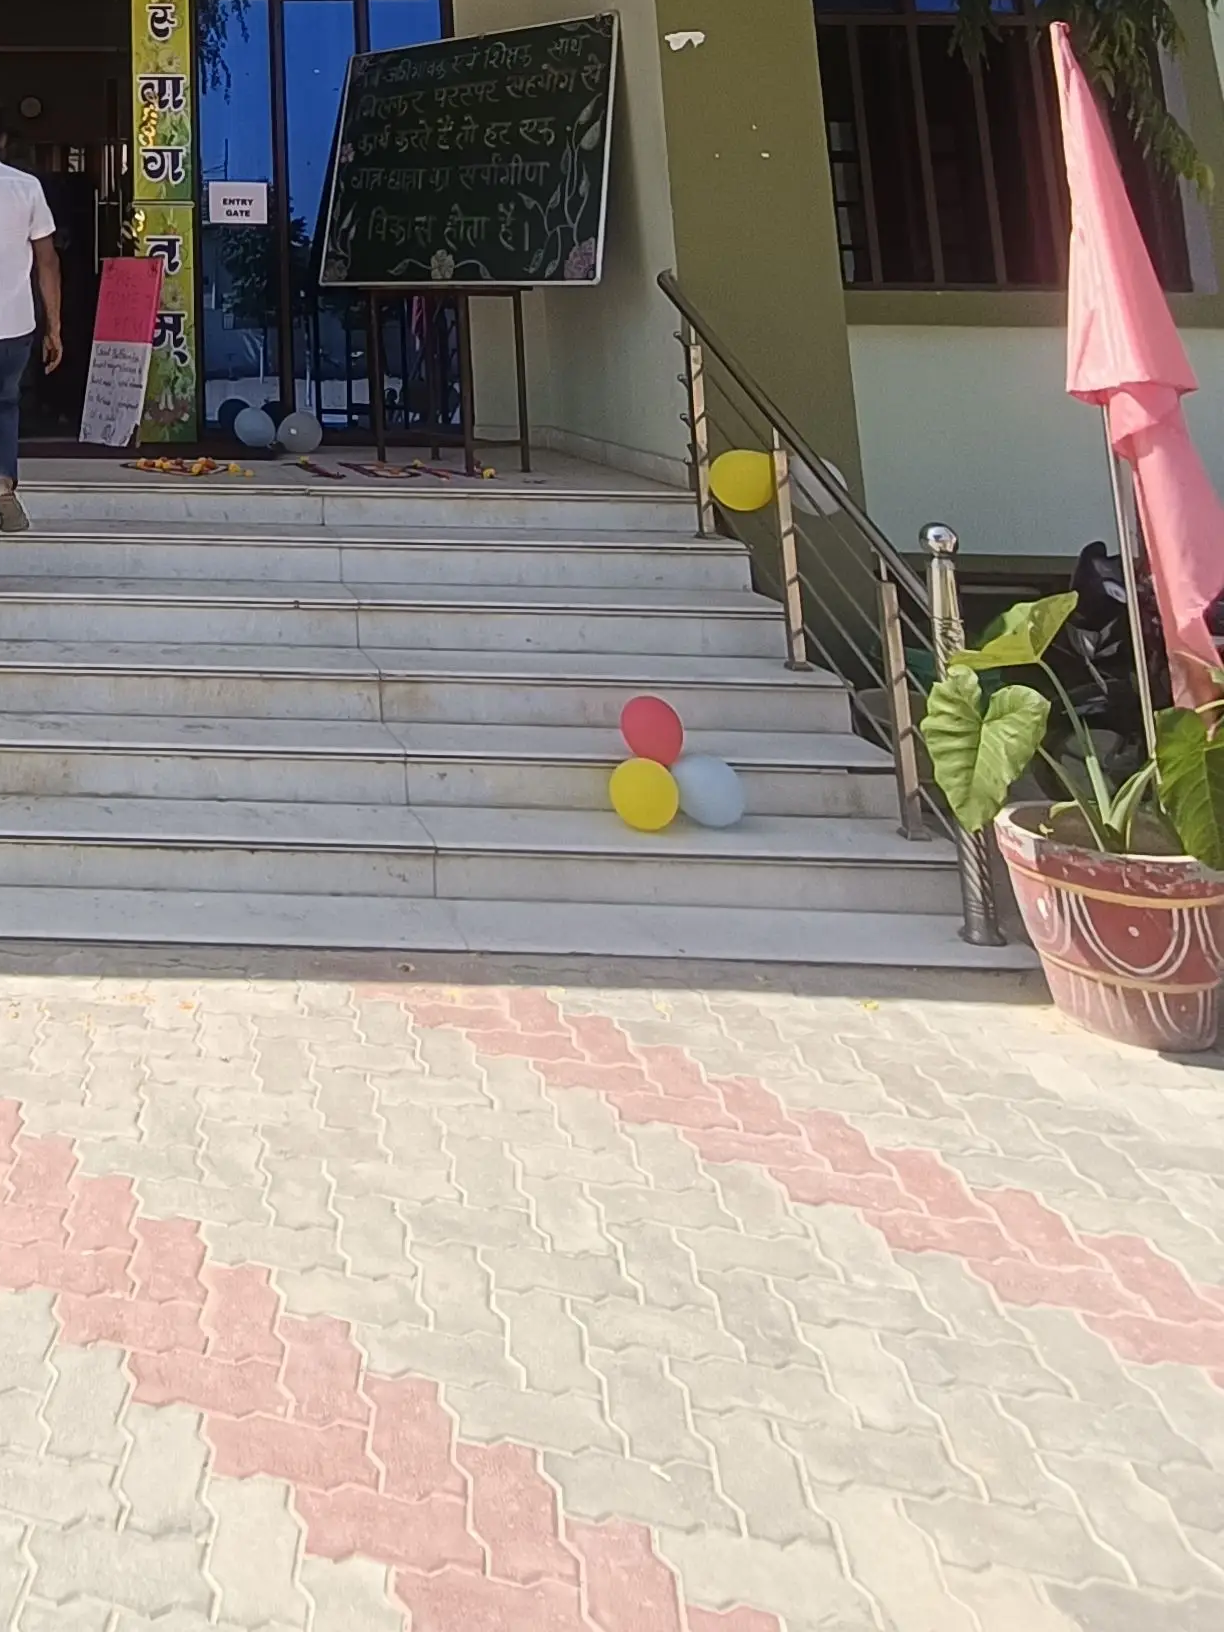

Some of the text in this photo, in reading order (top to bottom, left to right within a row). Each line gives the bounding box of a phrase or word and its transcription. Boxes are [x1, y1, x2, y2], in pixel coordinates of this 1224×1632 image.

[547, 34, 591, 61] साथ
[394, 119, 434, 153] करते
[456, 114, 480, 150] तो
[483, 121, 513, 149] हर
[519, 116, 556, 146] एक
[222, 197, 254, 207] ENTRY
[224, 209, 251, 218] GATE
[368, 206, 437, 246] विकास
[443, 202, 491, 251] होता
